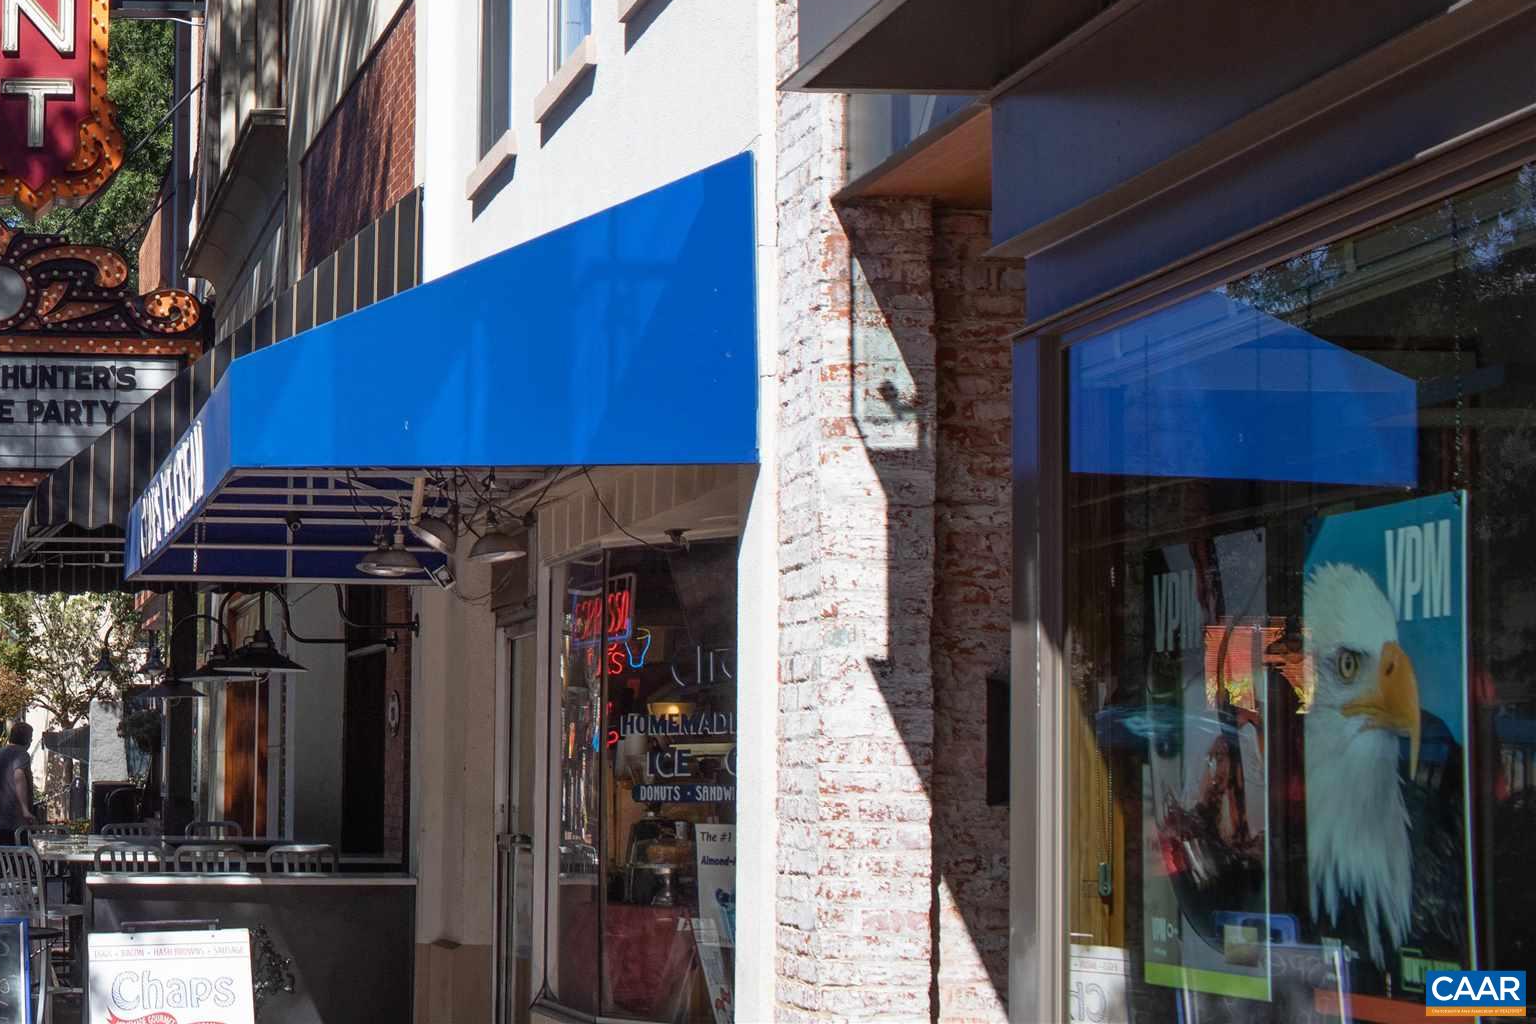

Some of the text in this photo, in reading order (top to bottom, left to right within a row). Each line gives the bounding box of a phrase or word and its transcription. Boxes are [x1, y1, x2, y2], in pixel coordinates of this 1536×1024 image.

[1, 365, 137, 392] HUNTER'S
[26, 400, 121, 427] PARTY
[1384, 519, 1452, 622] VPM
[1152, 569, 1202, 652] VPM
[647, 749, 692, 778] ICE
[640, 785, 681, 801] DONUTS
[700, 832, 717, 842] The
[153, 947, 173, 956] HASH
[111, 970, 236, 1010] Chaps
